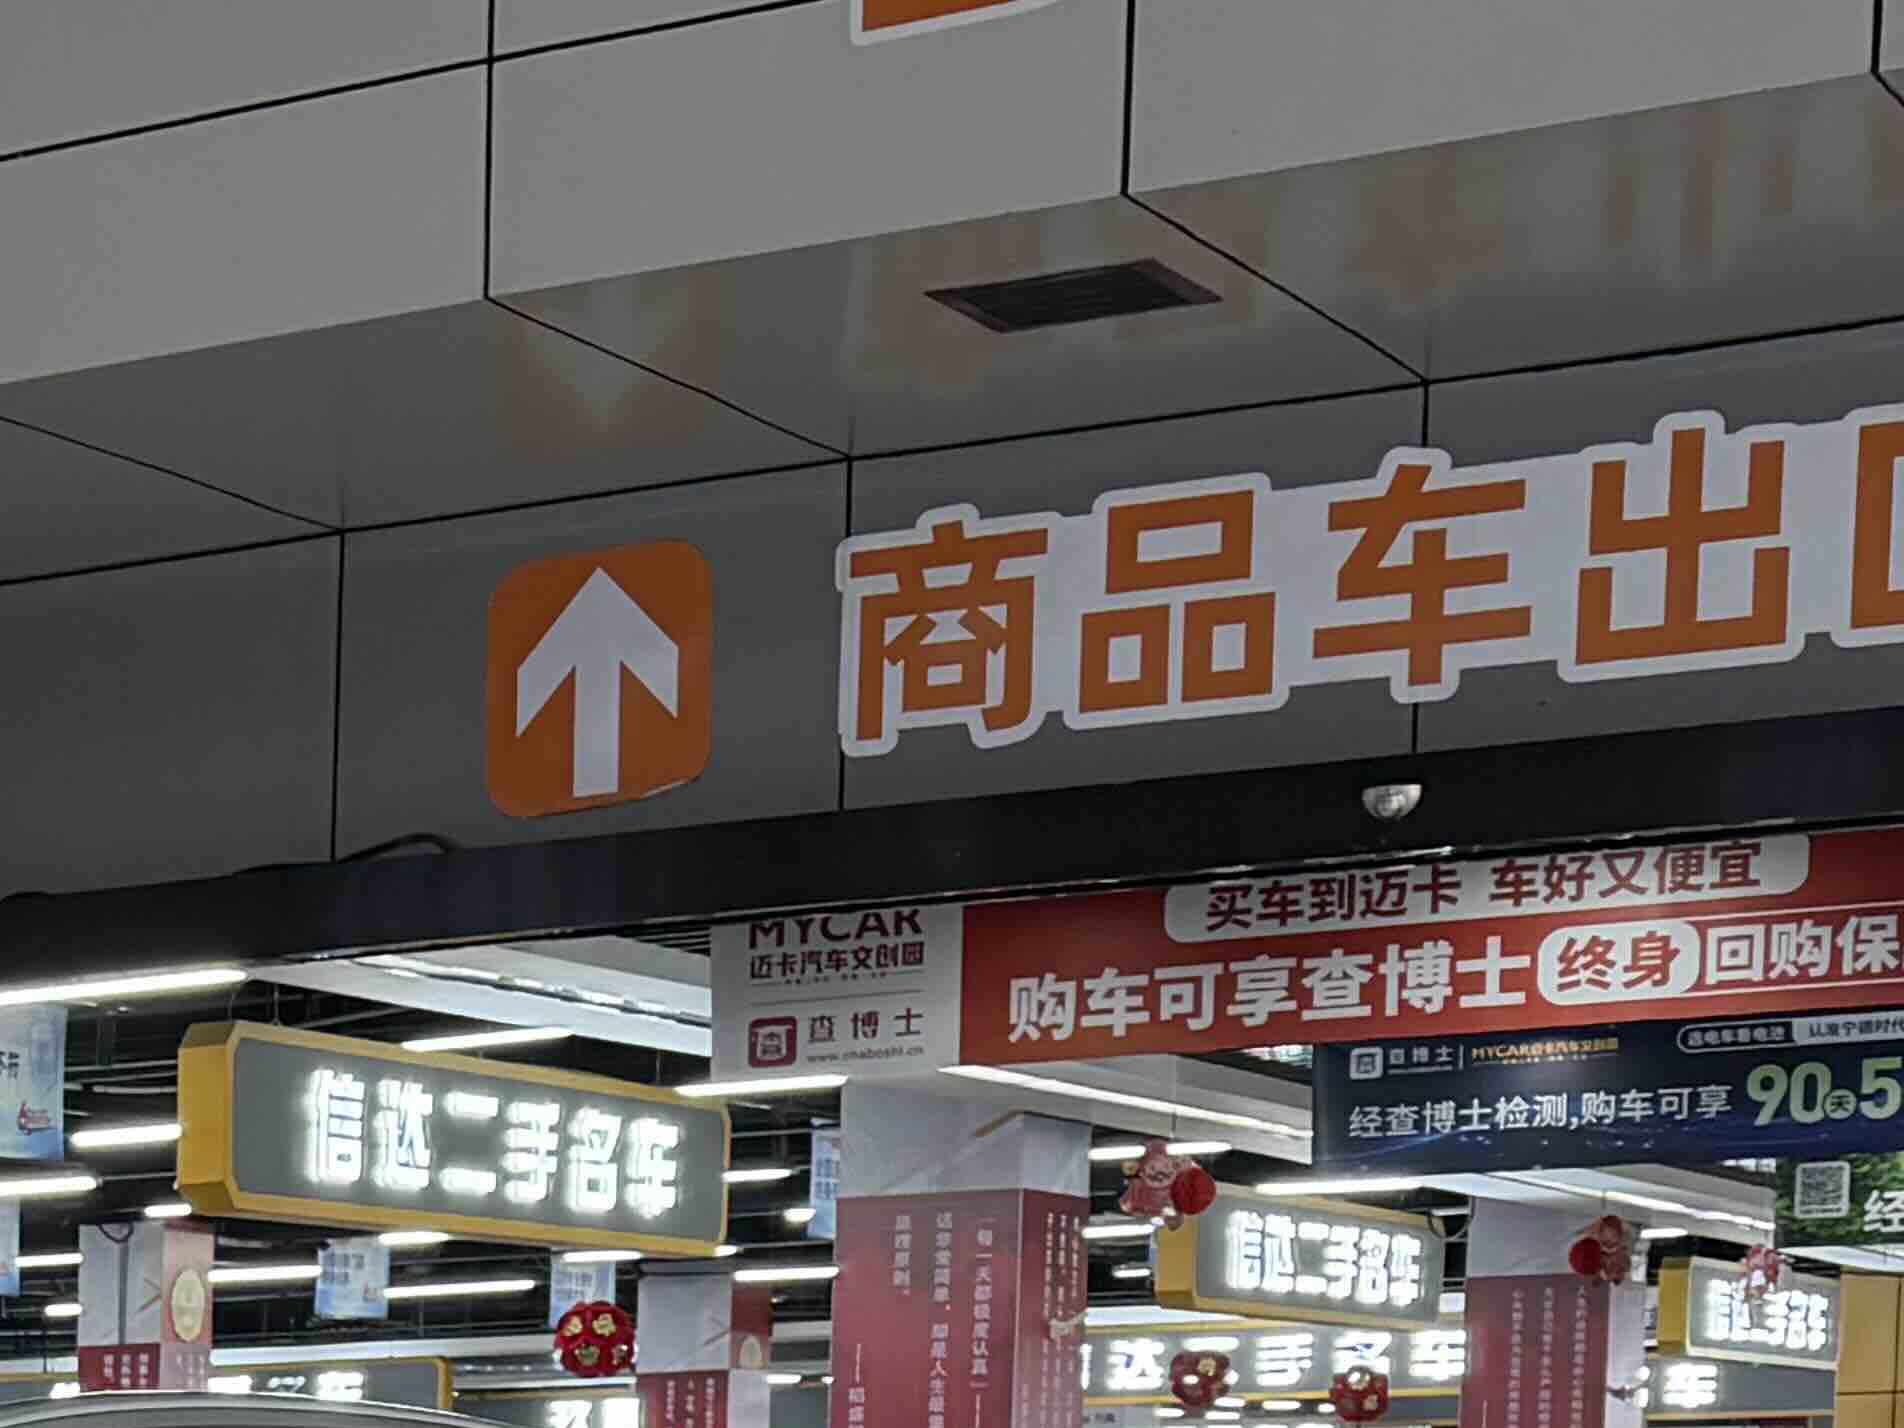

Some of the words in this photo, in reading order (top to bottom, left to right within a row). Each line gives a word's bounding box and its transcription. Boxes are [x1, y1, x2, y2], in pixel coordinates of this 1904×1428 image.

[1206, 862, 1463, 931] 买车到迈卡
[1489, 840, 1762, 907] 车好又便宜
[750, 941, 925, 980] 迈卡汽车文创园
[808, 1007, 924, 1044] 查博士
[306, 1066, 683, 1218] 信达二手名车
[1226, 1209, 1423, 1307] 信达二手名车
[1081, 1328, 1467, 1392] 达二手名车
